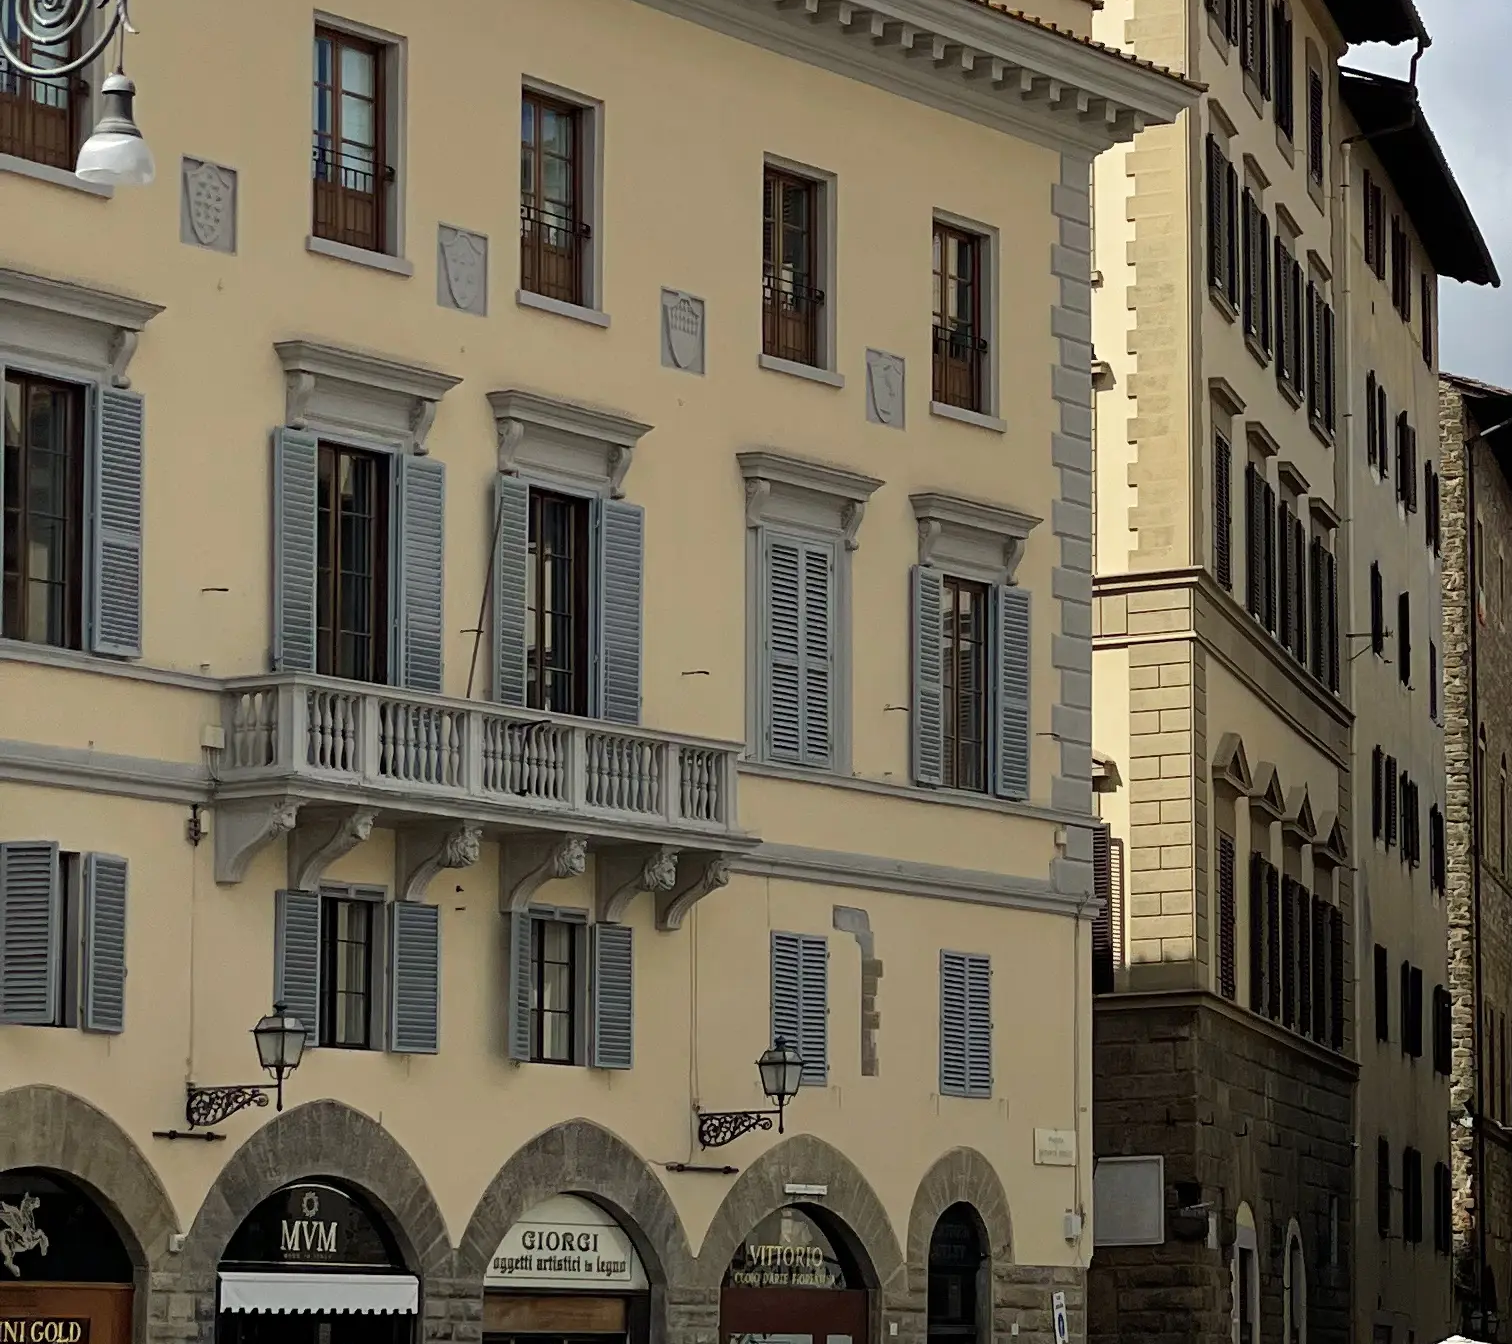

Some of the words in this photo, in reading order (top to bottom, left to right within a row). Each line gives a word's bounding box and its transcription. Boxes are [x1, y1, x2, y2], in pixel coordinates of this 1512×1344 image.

[280, 1219, 338, 1253] MVM
[521, 1230, 599, 1252] GIORGI
[493, 1255, 533, 1274] oggetti
[537, 1255, 581, 1273] artistici
[596, 1255, 627, 1276] legno
[750, 1244, 823, 1267] VITTORIO
[30, 1321, 81, 1343] GOLD
